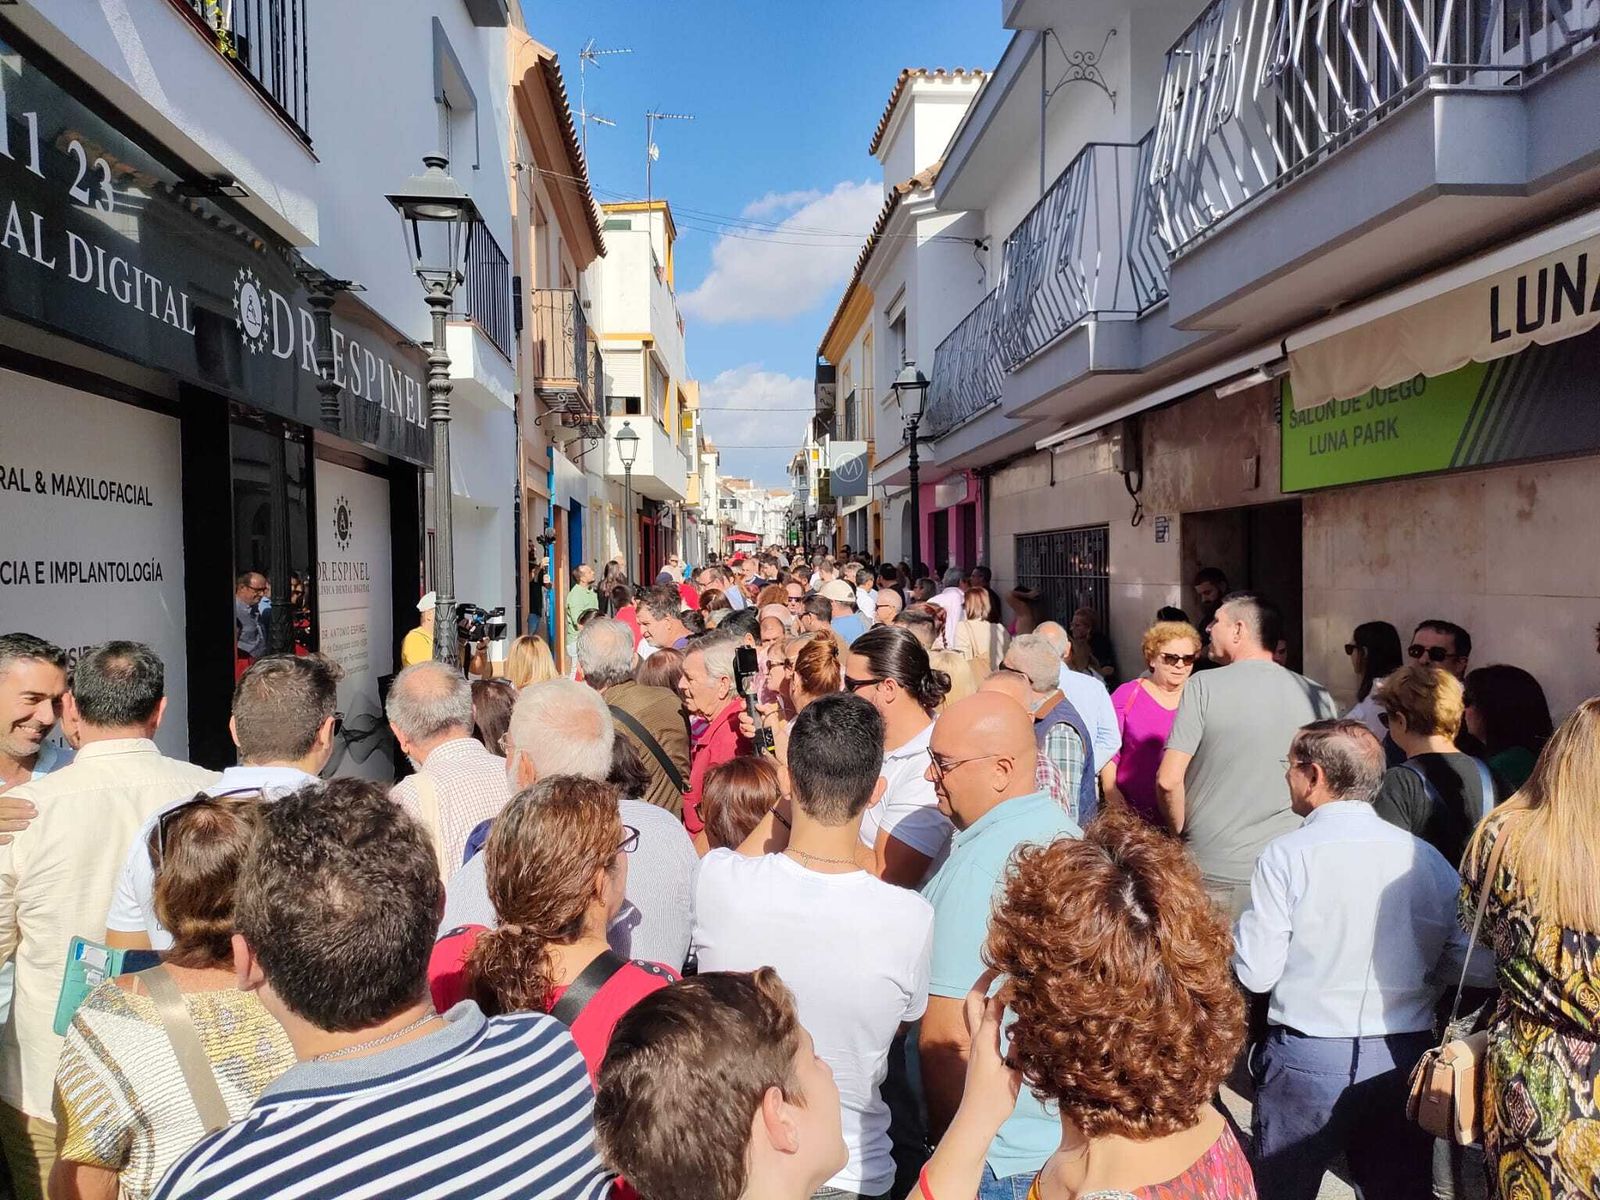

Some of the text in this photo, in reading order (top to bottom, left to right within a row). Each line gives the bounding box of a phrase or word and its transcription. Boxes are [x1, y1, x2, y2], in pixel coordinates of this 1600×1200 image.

[67, 139, 115, 213] 23
[0, 200, 196, 336] AL DIGITAL
[1309, 416, 1399, 456] LUNA PARK
[34, 470, 47, 494] &
[51, 472, 153, 507] MAXILOFACIAL
[35, 561, 45, 584] E
[50, 557, 164, 584] IMPLANTOLOGÍA
